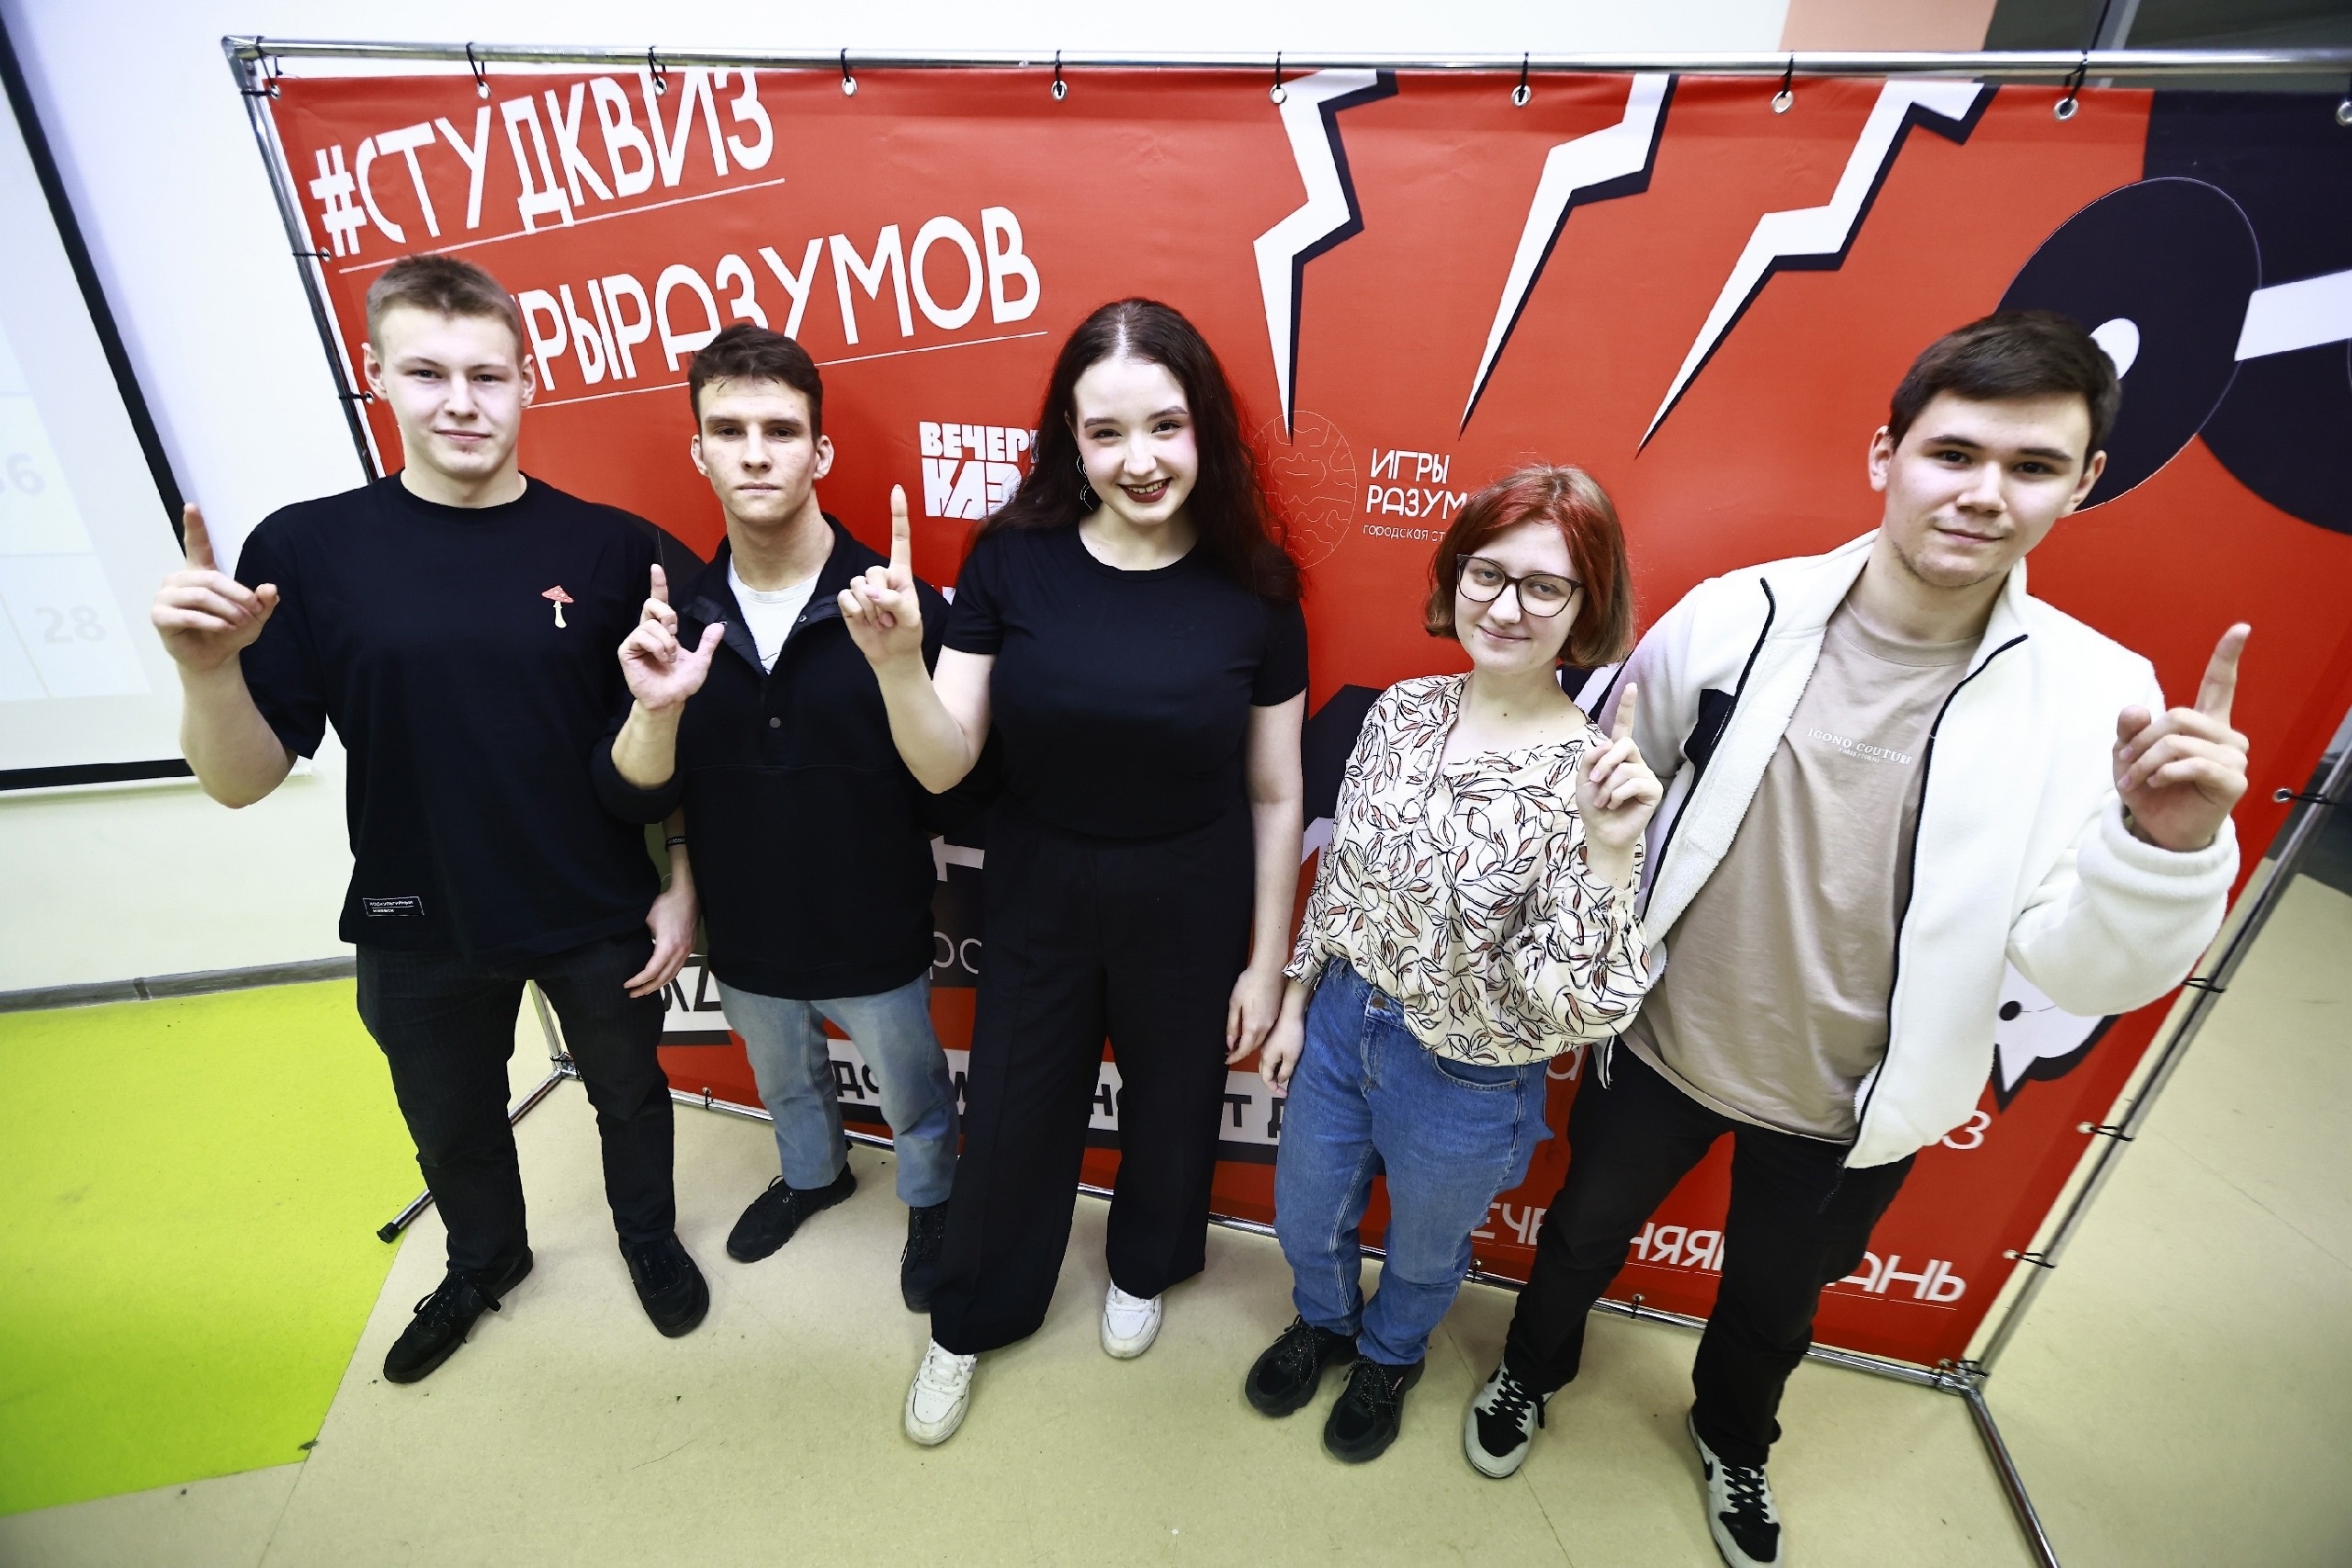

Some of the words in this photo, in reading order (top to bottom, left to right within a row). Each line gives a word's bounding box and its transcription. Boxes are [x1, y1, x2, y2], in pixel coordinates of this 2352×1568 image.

[309, 67, 775, 257] #СТУДКВИЗ
[510, 206, 1040, 391] РЫРАЗУМОВ
[0, 452, 47, 497] 6
[1370, 447, 1451, 485] ИГРЫ
[1365, 484, 1468, 521] РАЗУМ
[1363, 524, 1429, 541] городская
[33, 604, 107, 643] 28
[1807, 727, 1853, 749] ICONO
